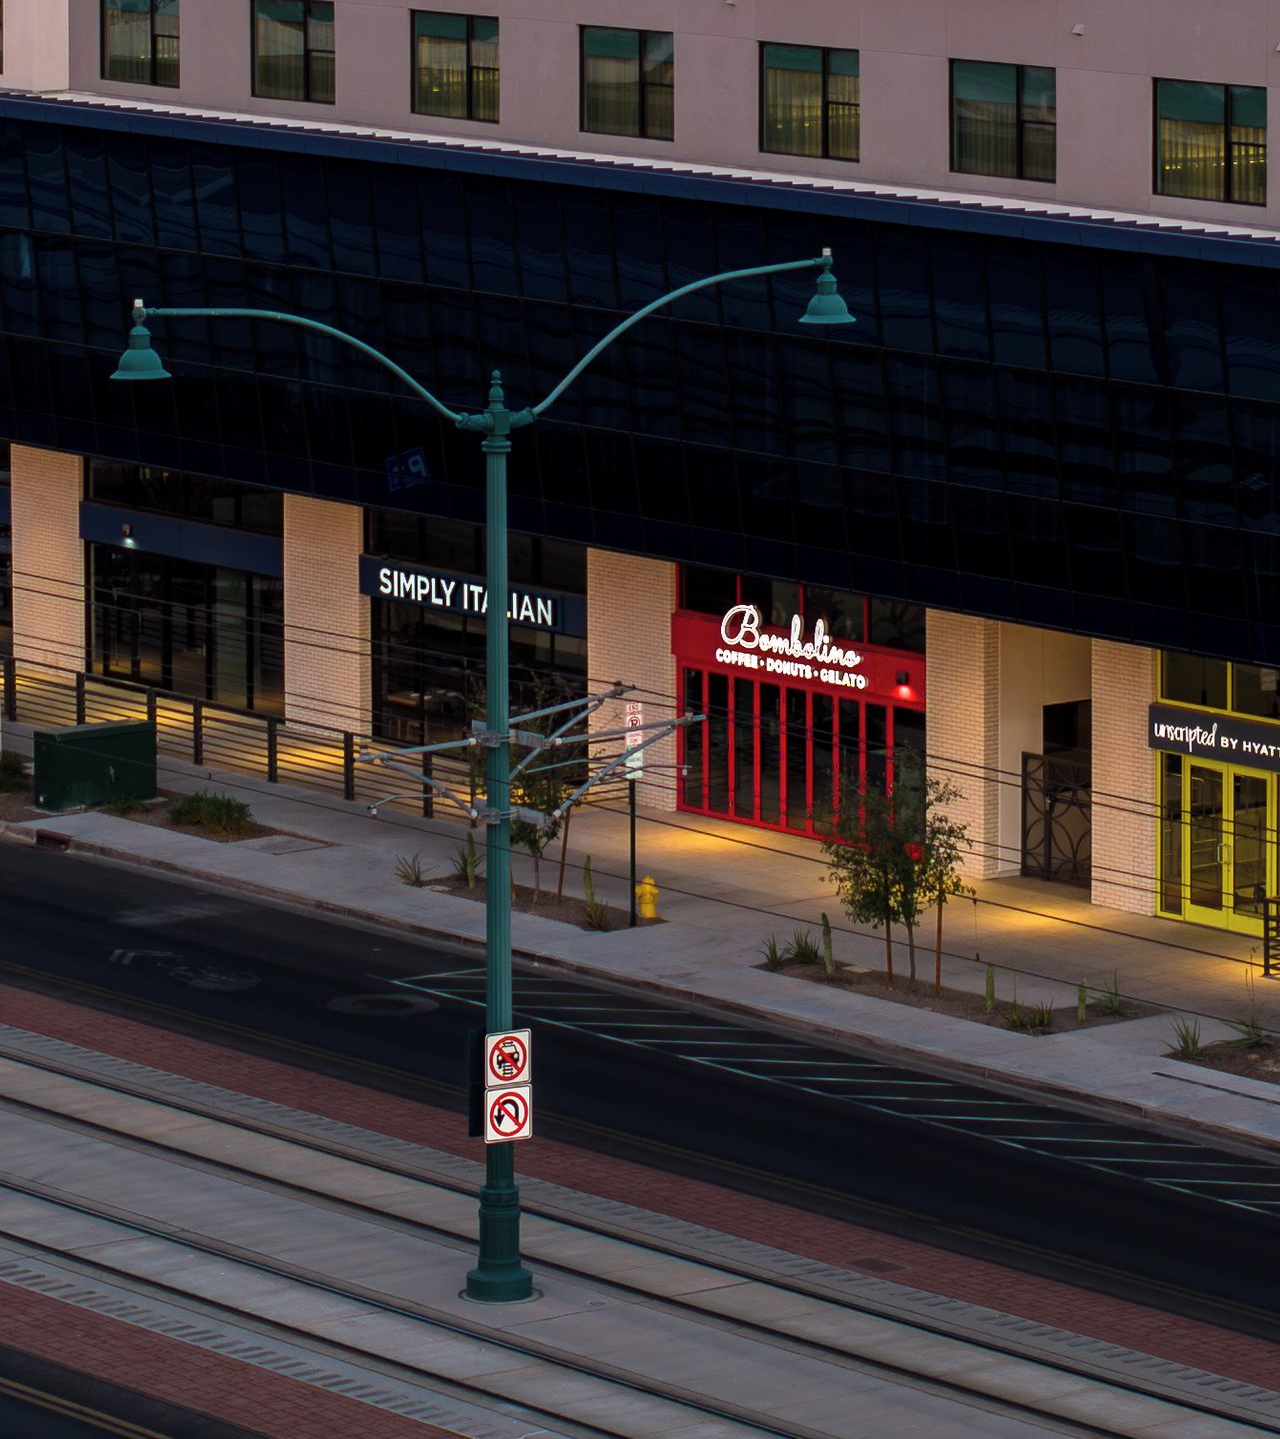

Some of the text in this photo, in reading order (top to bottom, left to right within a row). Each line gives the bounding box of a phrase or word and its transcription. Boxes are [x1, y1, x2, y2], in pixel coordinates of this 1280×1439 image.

[379, 567, 456, 607] SIMPLY
[716, 648, 867, 689] COFFEE DONUTS GELATO
[1154, 722, 1218, 753] unscripted
[1220, 736, 1238, 750] BY
